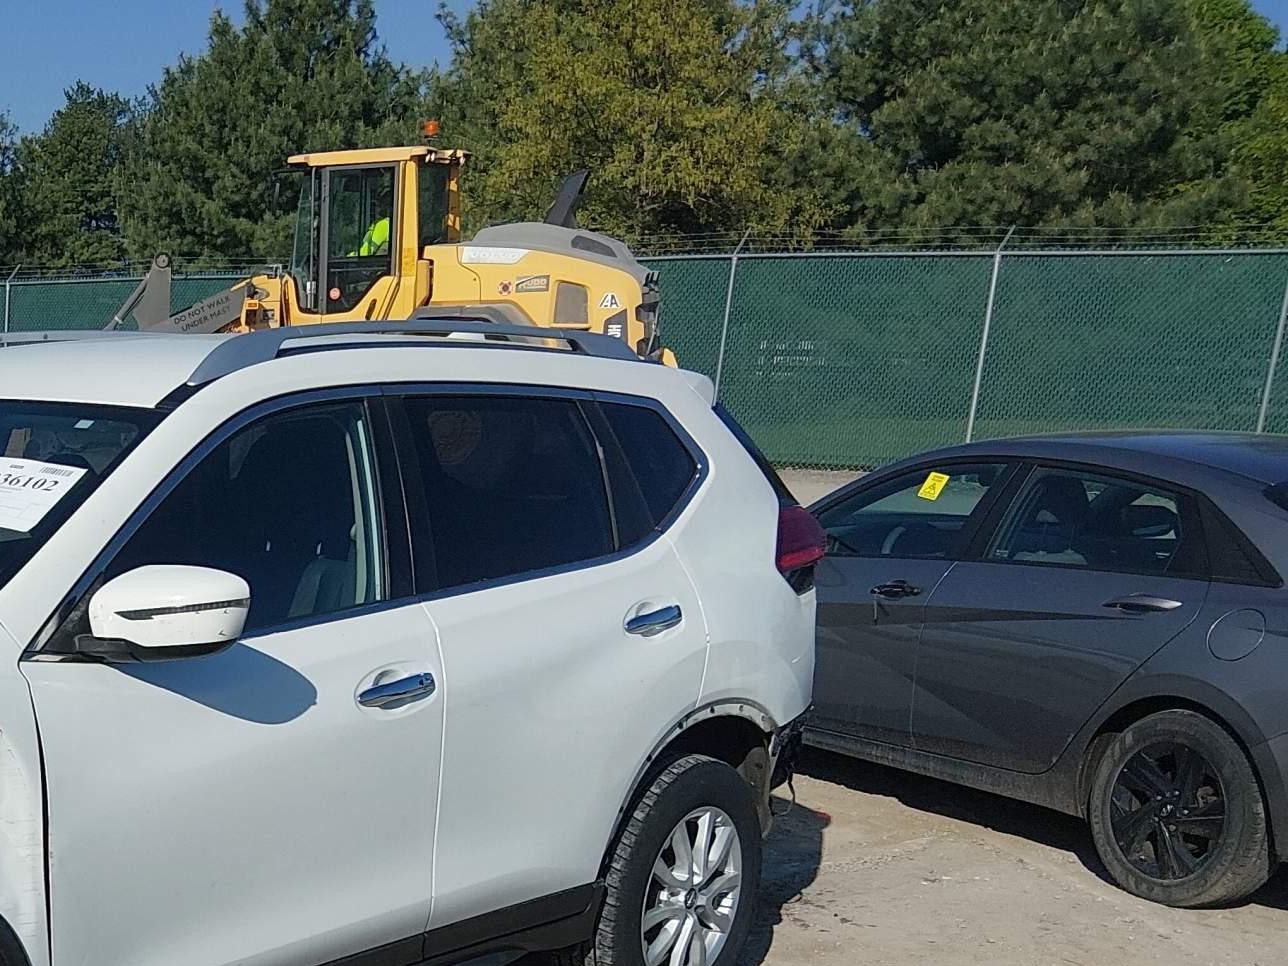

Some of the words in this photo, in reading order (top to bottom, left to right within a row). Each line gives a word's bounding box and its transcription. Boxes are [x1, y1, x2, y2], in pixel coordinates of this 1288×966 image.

[174, 315, 186, 325] DO
[188, 305, 205, 319] NOT
[207, 296, 230, 309] WALK
[181, 316, 208, 331] UNDER
[210, 305, 231, 320] MAST
